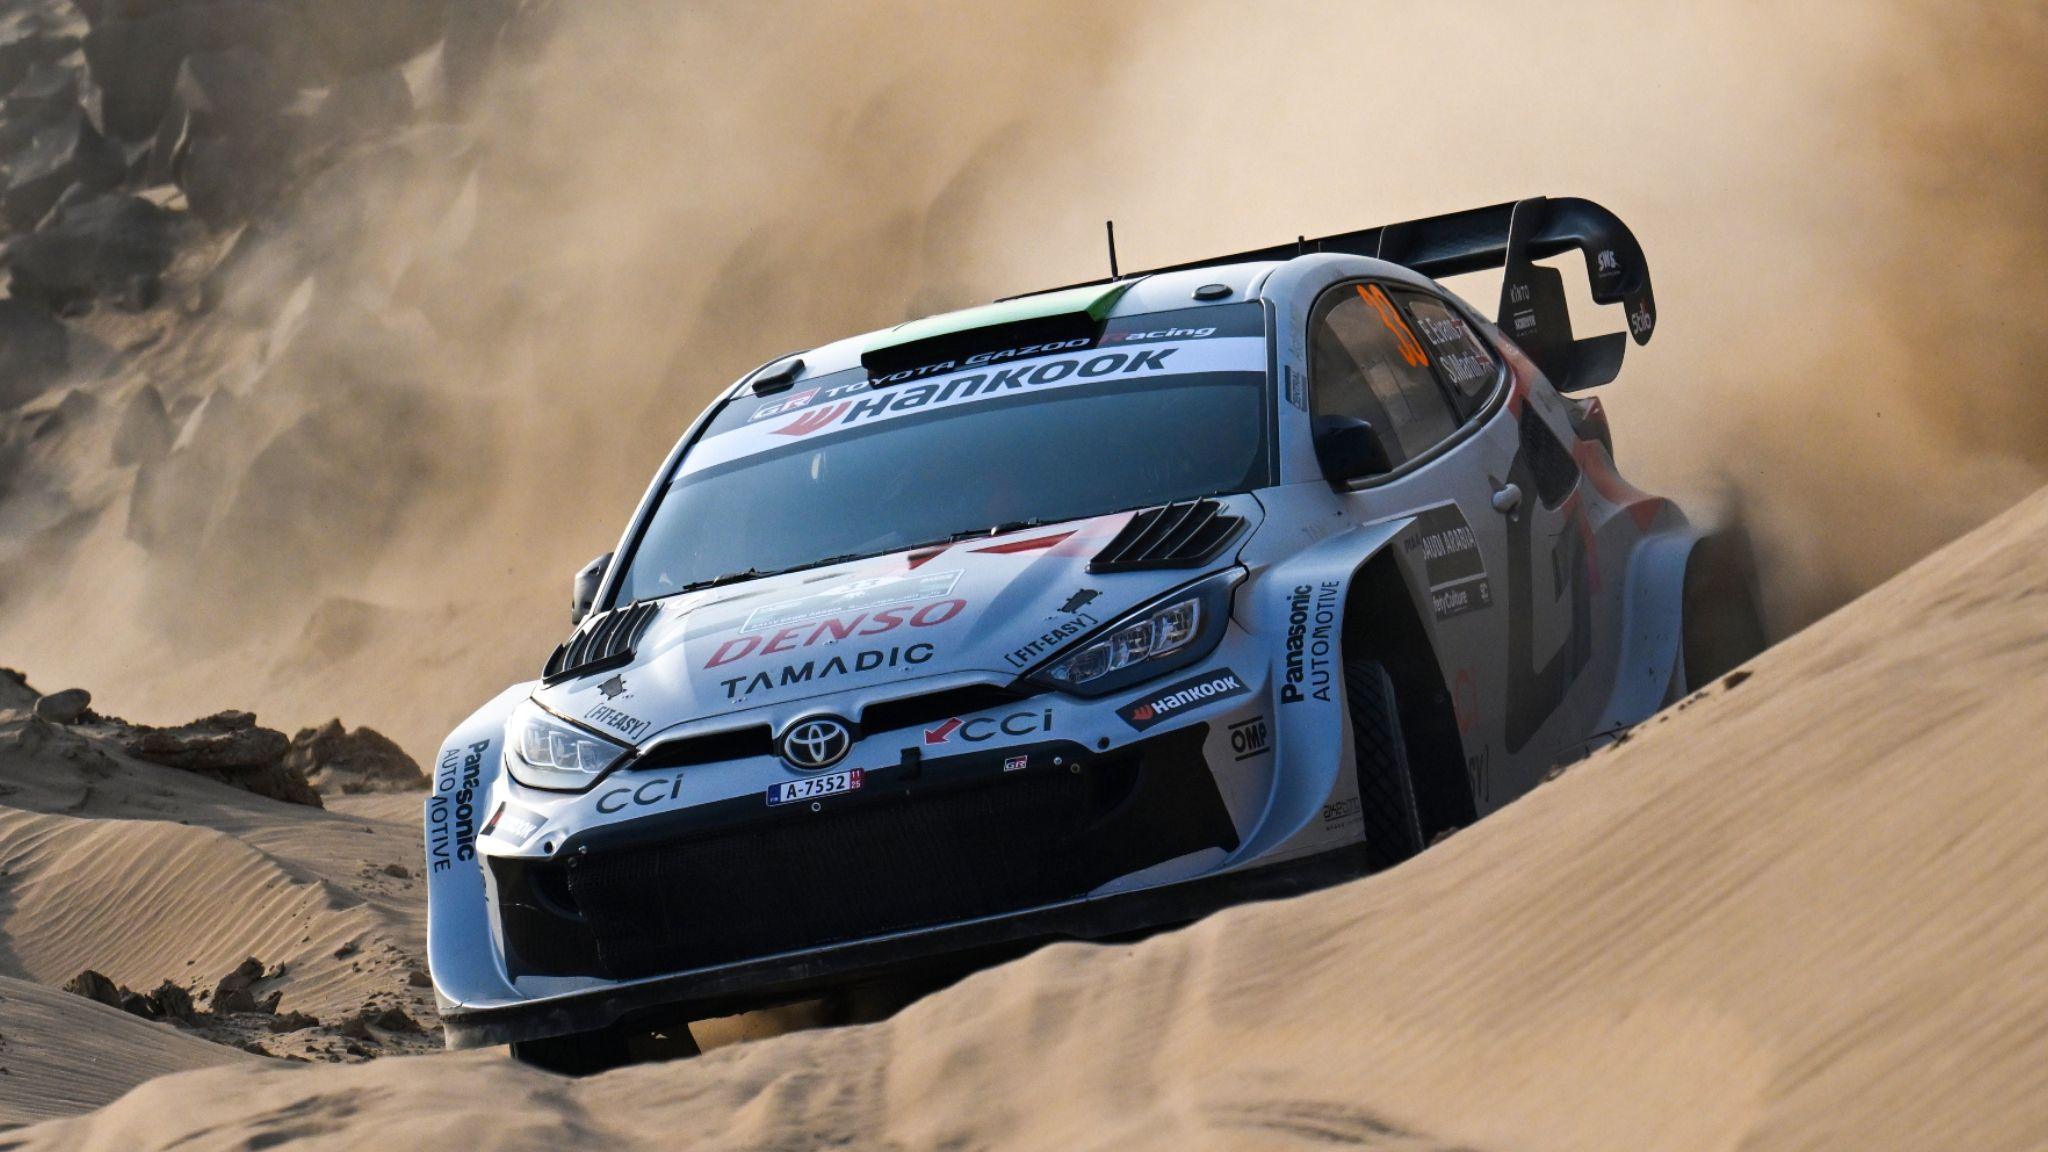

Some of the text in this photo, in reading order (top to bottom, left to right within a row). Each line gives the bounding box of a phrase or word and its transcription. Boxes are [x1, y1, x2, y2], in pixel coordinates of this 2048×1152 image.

[1356, 283, 1429, 368] 33
[824, 359, 957, 398] TOYOTA
[964, 338, 1091, 366] GAZOO
[703, 599, 968, 670] DENSO
[1281, 584, 1314, 705] Panasonic
[1312, 579, 1341, 702] AUTOMOTIVE
[720, 642, 936, 700] TAMADIC
[1005, 759, 1026, 770] GR
[1231, 722, 1269, 753] OMP
[455, 739, 491, 862] Panasonic
[787, 775, 845, 799] A-7552
